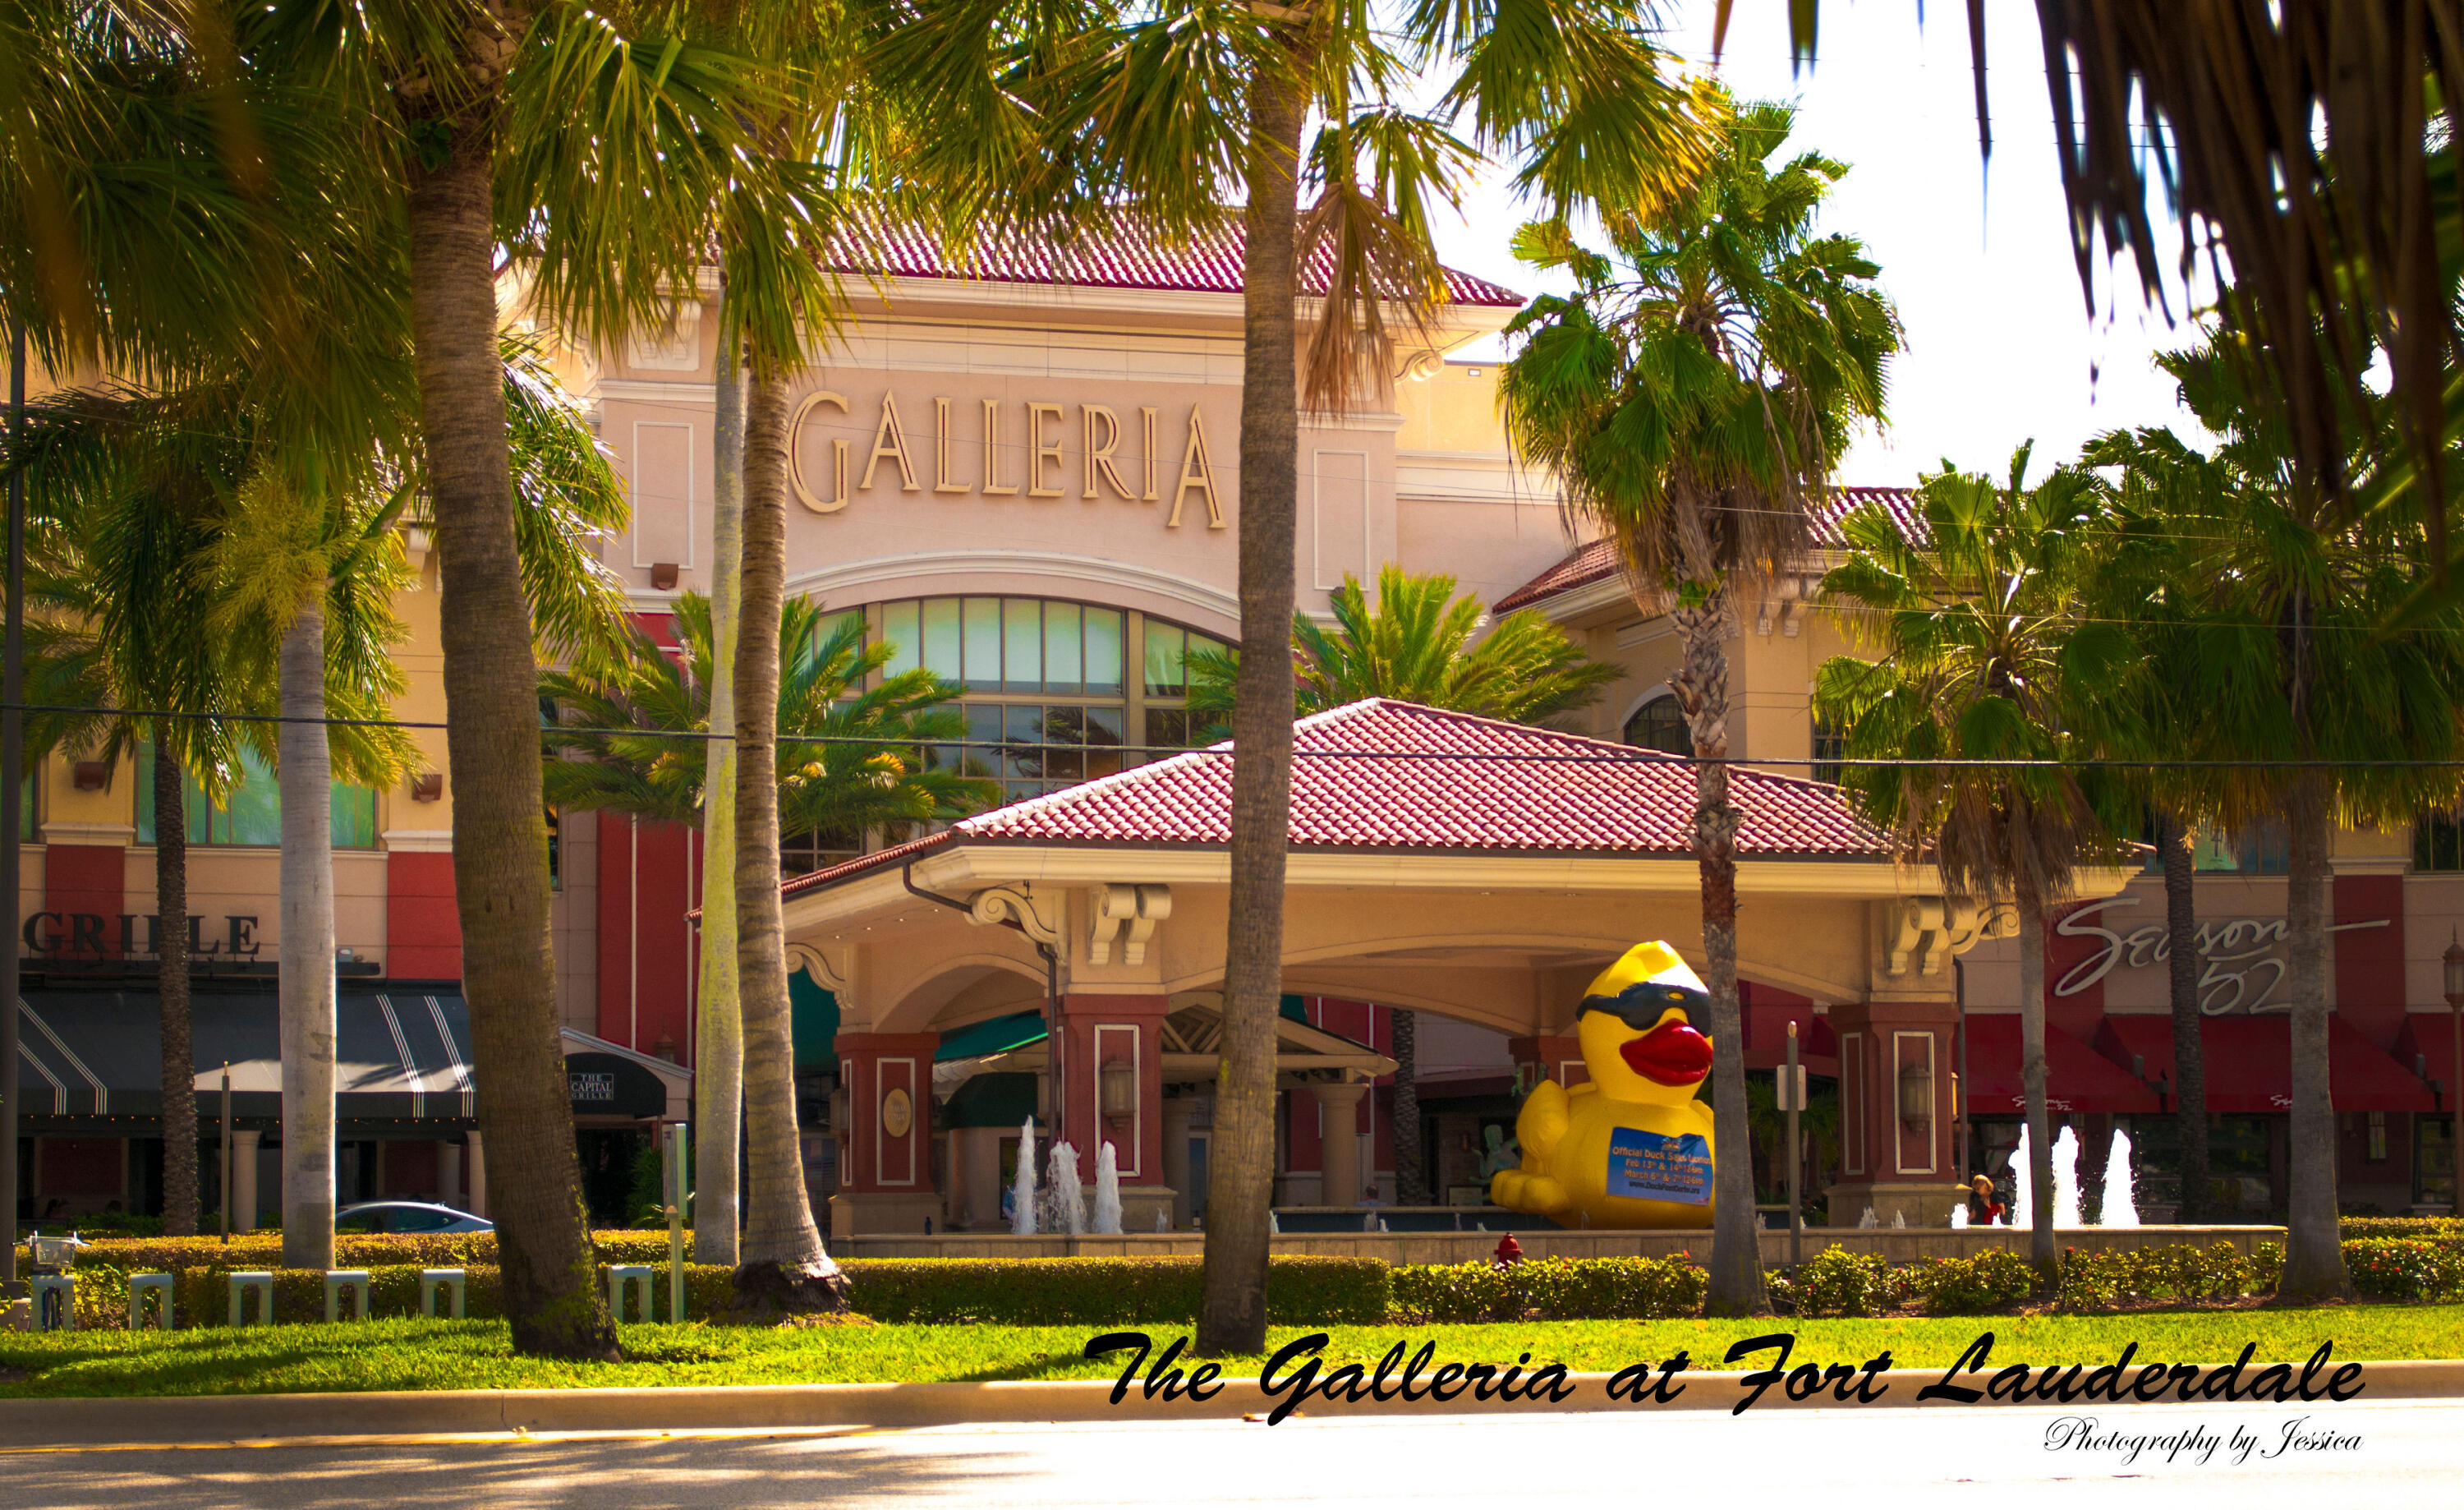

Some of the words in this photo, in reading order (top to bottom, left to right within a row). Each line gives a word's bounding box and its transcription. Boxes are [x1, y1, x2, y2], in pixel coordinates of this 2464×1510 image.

[788, 388, 1228, 529] GALLERIA
[2198, 945, 2296, 1015] 52
[581, 1074, 603, 1082] THE
[571, 1082, 612, 1092] CAPITAL
[1612, 1146, 1642, 1158] Official
[1644, 1149, 1665, 1160] Duck
[1625, 1158, 1640, 1167] Feb
[1659, 1162, 1666, 1171] &
[1625, 1169, 1648, 1180] March
[1662, 1173, 1671, 1182] &
